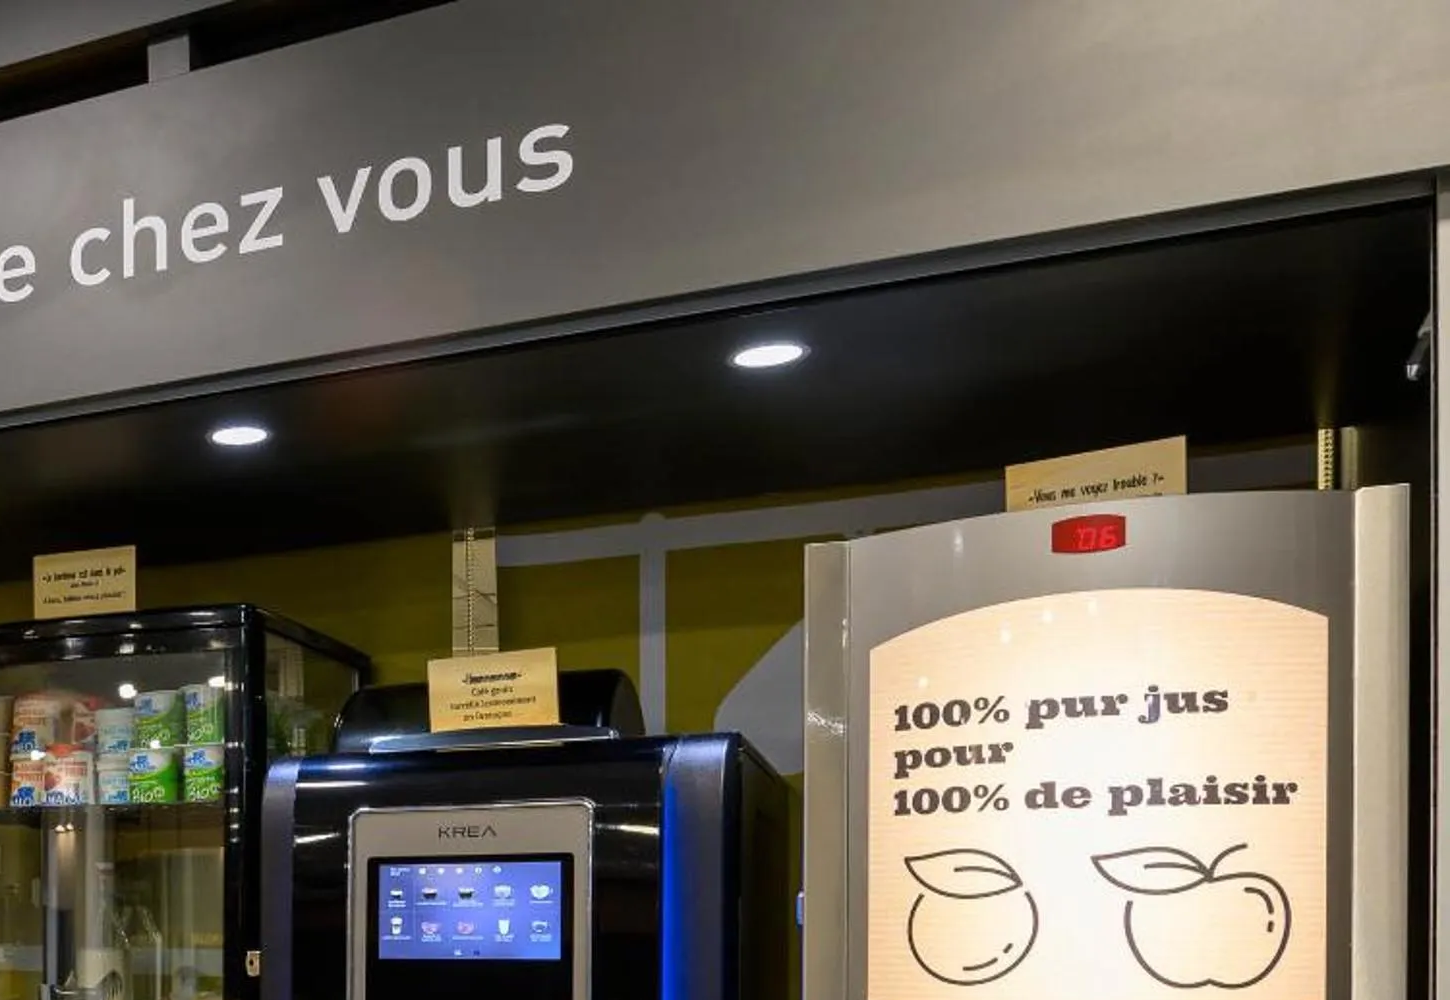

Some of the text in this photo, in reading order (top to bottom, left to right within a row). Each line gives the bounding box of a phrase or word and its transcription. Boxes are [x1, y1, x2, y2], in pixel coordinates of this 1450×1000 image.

[69, 187, 283, 286] chez
[317, 124, 574, 233] vous
[894, 685, 1229, 732] 100% pur jus
[894, 742, 1014, 780] pour
[894, 774, 1298, 816] 100% de plaisir
